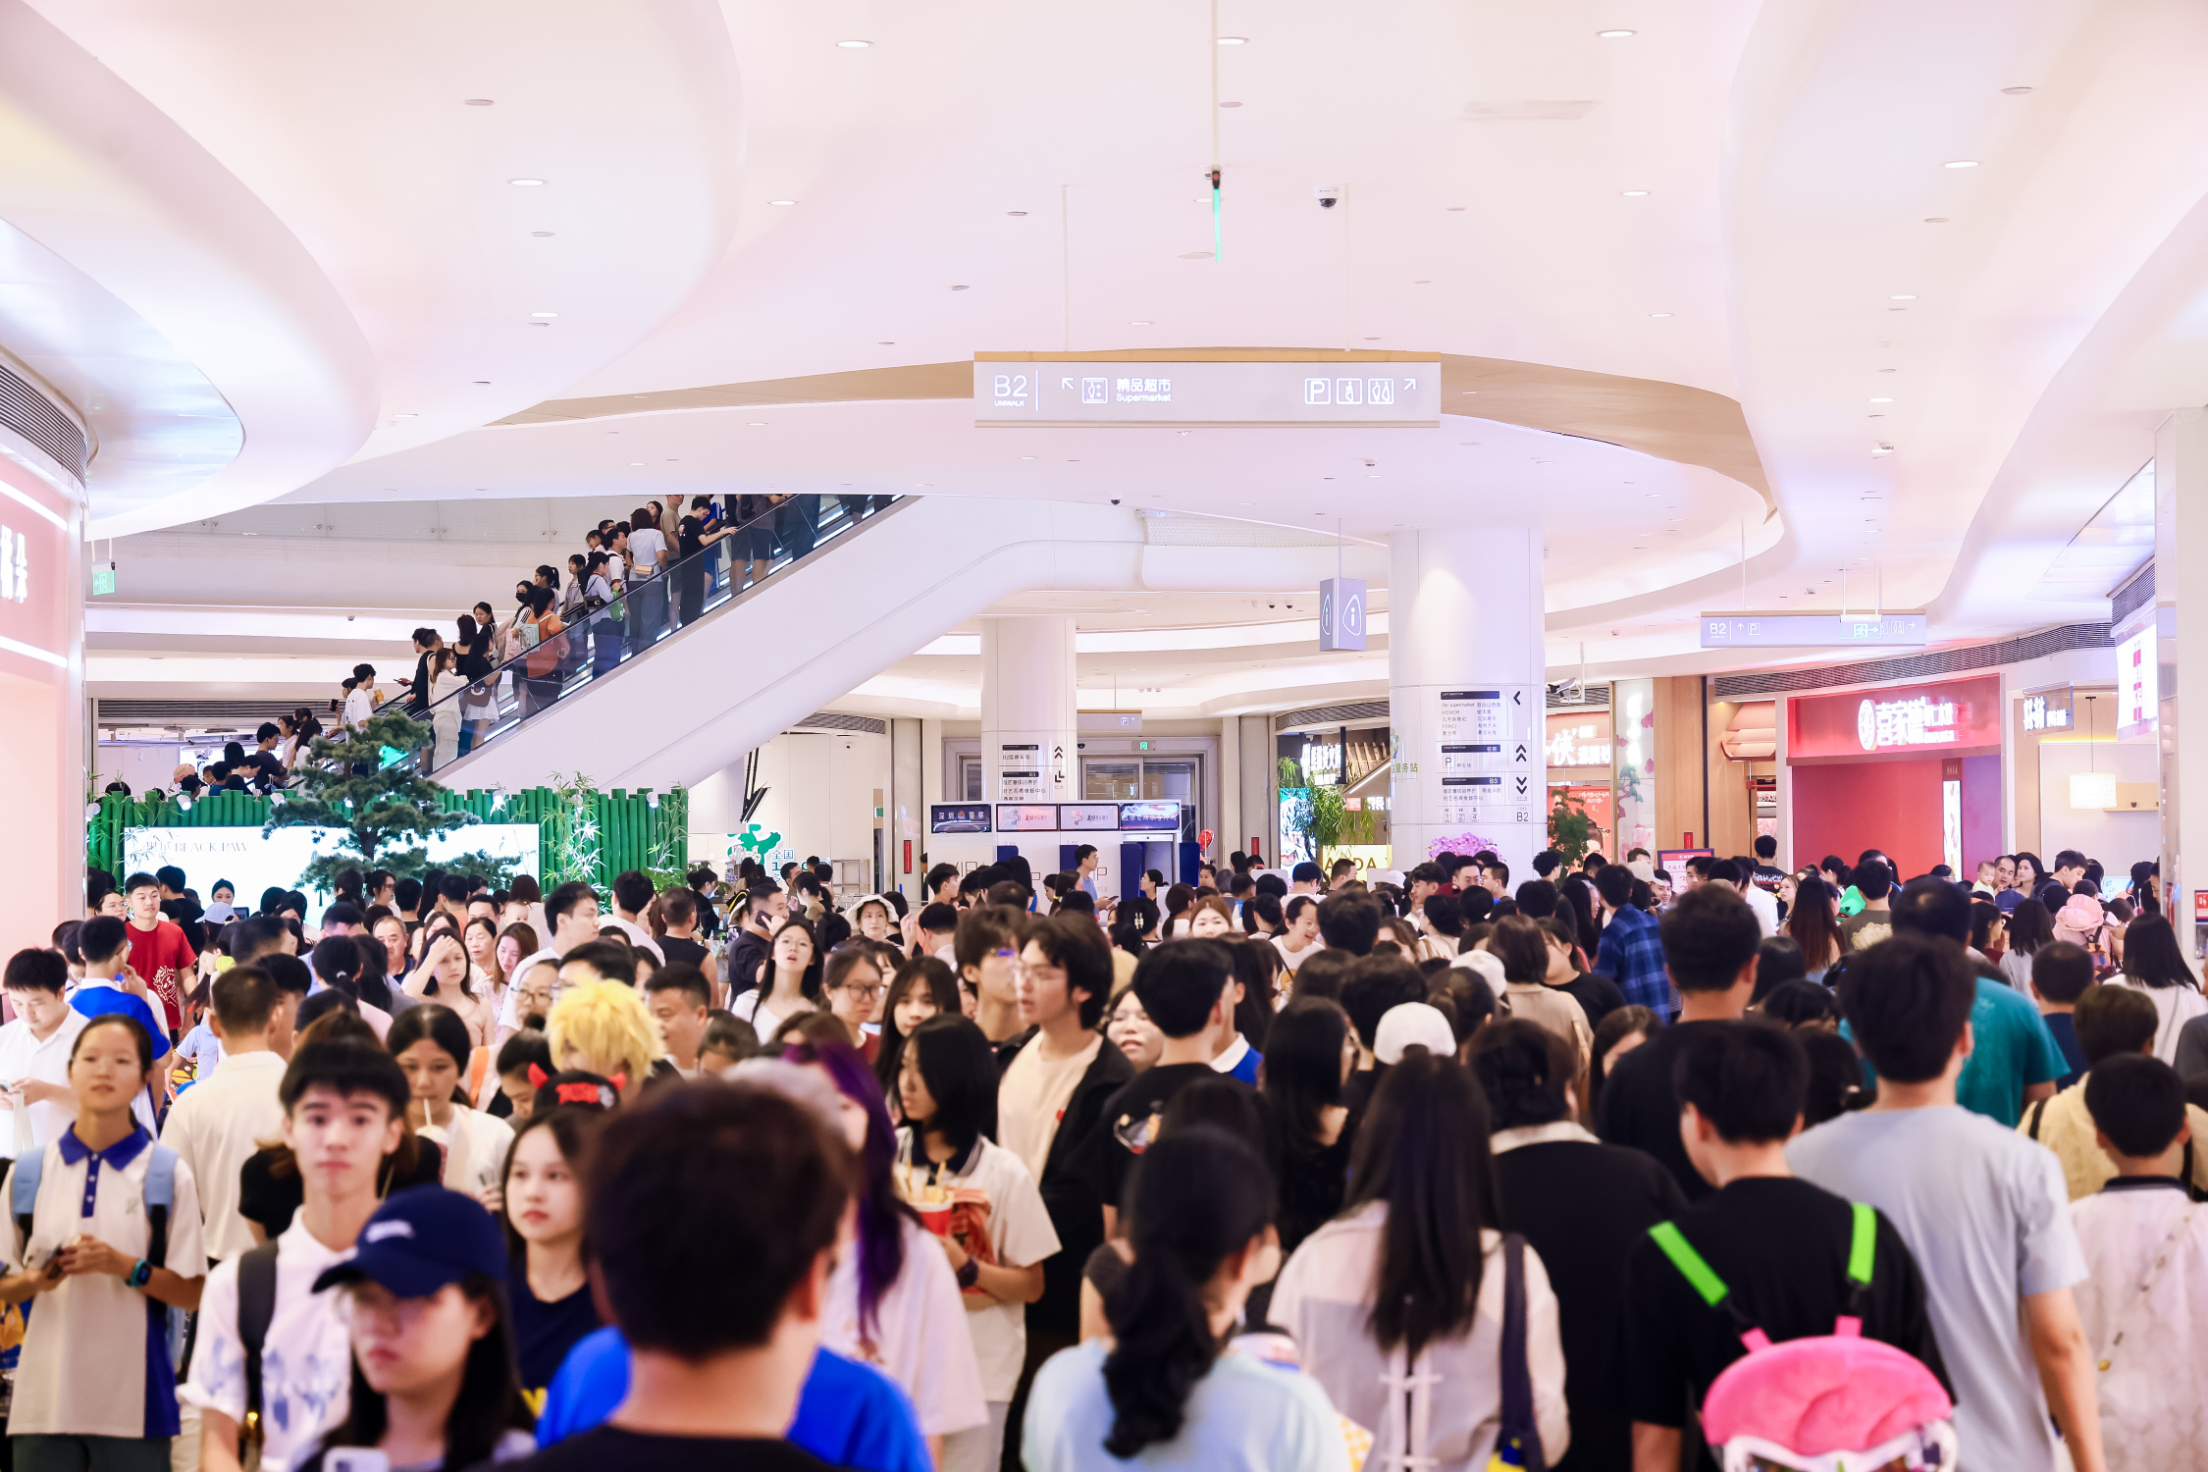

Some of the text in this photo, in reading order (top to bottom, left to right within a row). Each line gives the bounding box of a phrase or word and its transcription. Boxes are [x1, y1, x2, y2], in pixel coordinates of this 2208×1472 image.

[994, 374, 1028, 397] B2
[1116, 378, 1171, 392] 精品超市
[1116, 393, 1172, 403] Supermarket
[1709, 623, 1726, 635] B2
[1445, 757, 1452, 766] P
[939, 811, 984, 820] 深圳 警察
[1517, 812, 1528, 821] B2
[175, 842, 217, 852] BLACK
[222, 842, 249, 852] PAW
[772, 850, 794, 860] 全国
[1325, 857, 1377, 871] ADA
